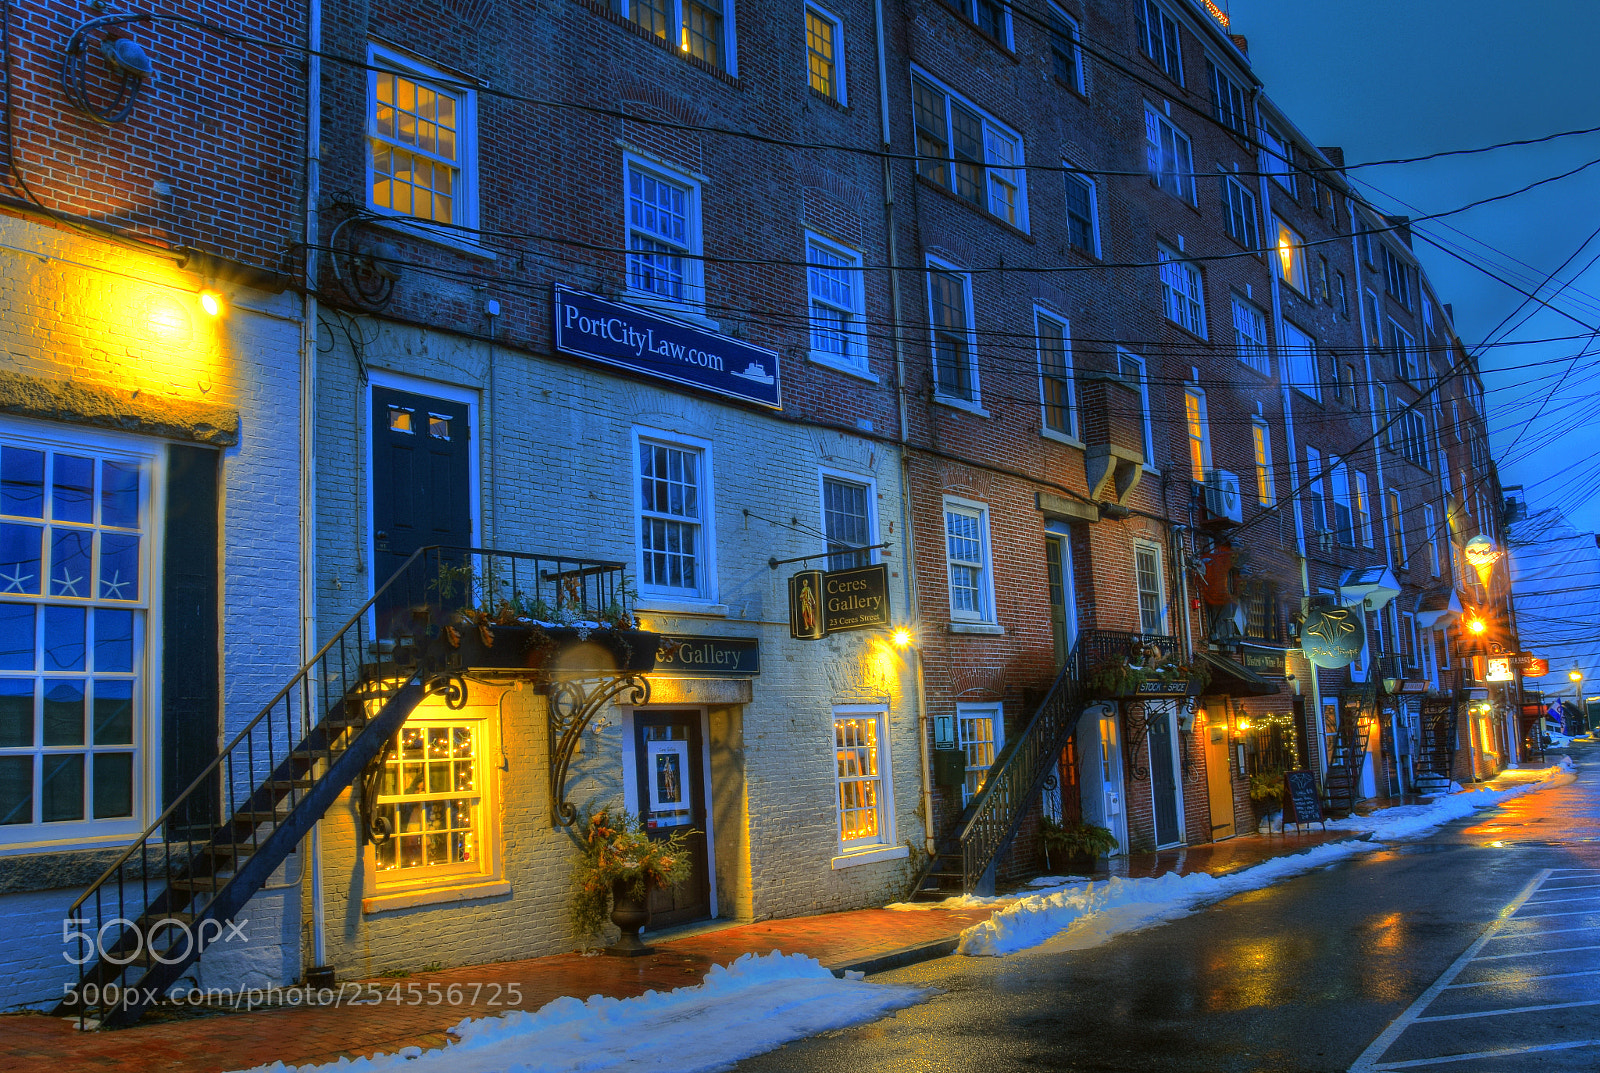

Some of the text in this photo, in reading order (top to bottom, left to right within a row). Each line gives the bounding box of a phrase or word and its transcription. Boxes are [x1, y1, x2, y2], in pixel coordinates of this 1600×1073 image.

[564, 304, 724, 372] PortCityLaw.com
[827, 579, 867, 594] Ceres
[828, 595, 882, 612] Gallery
[829, 614, 881, 626] 23 Ceres Street
[679, 643, 741, 670] Gallery
[1140, 682, 1161, 691] STOCK
[1167, 683, 1187, 691] SPICE
